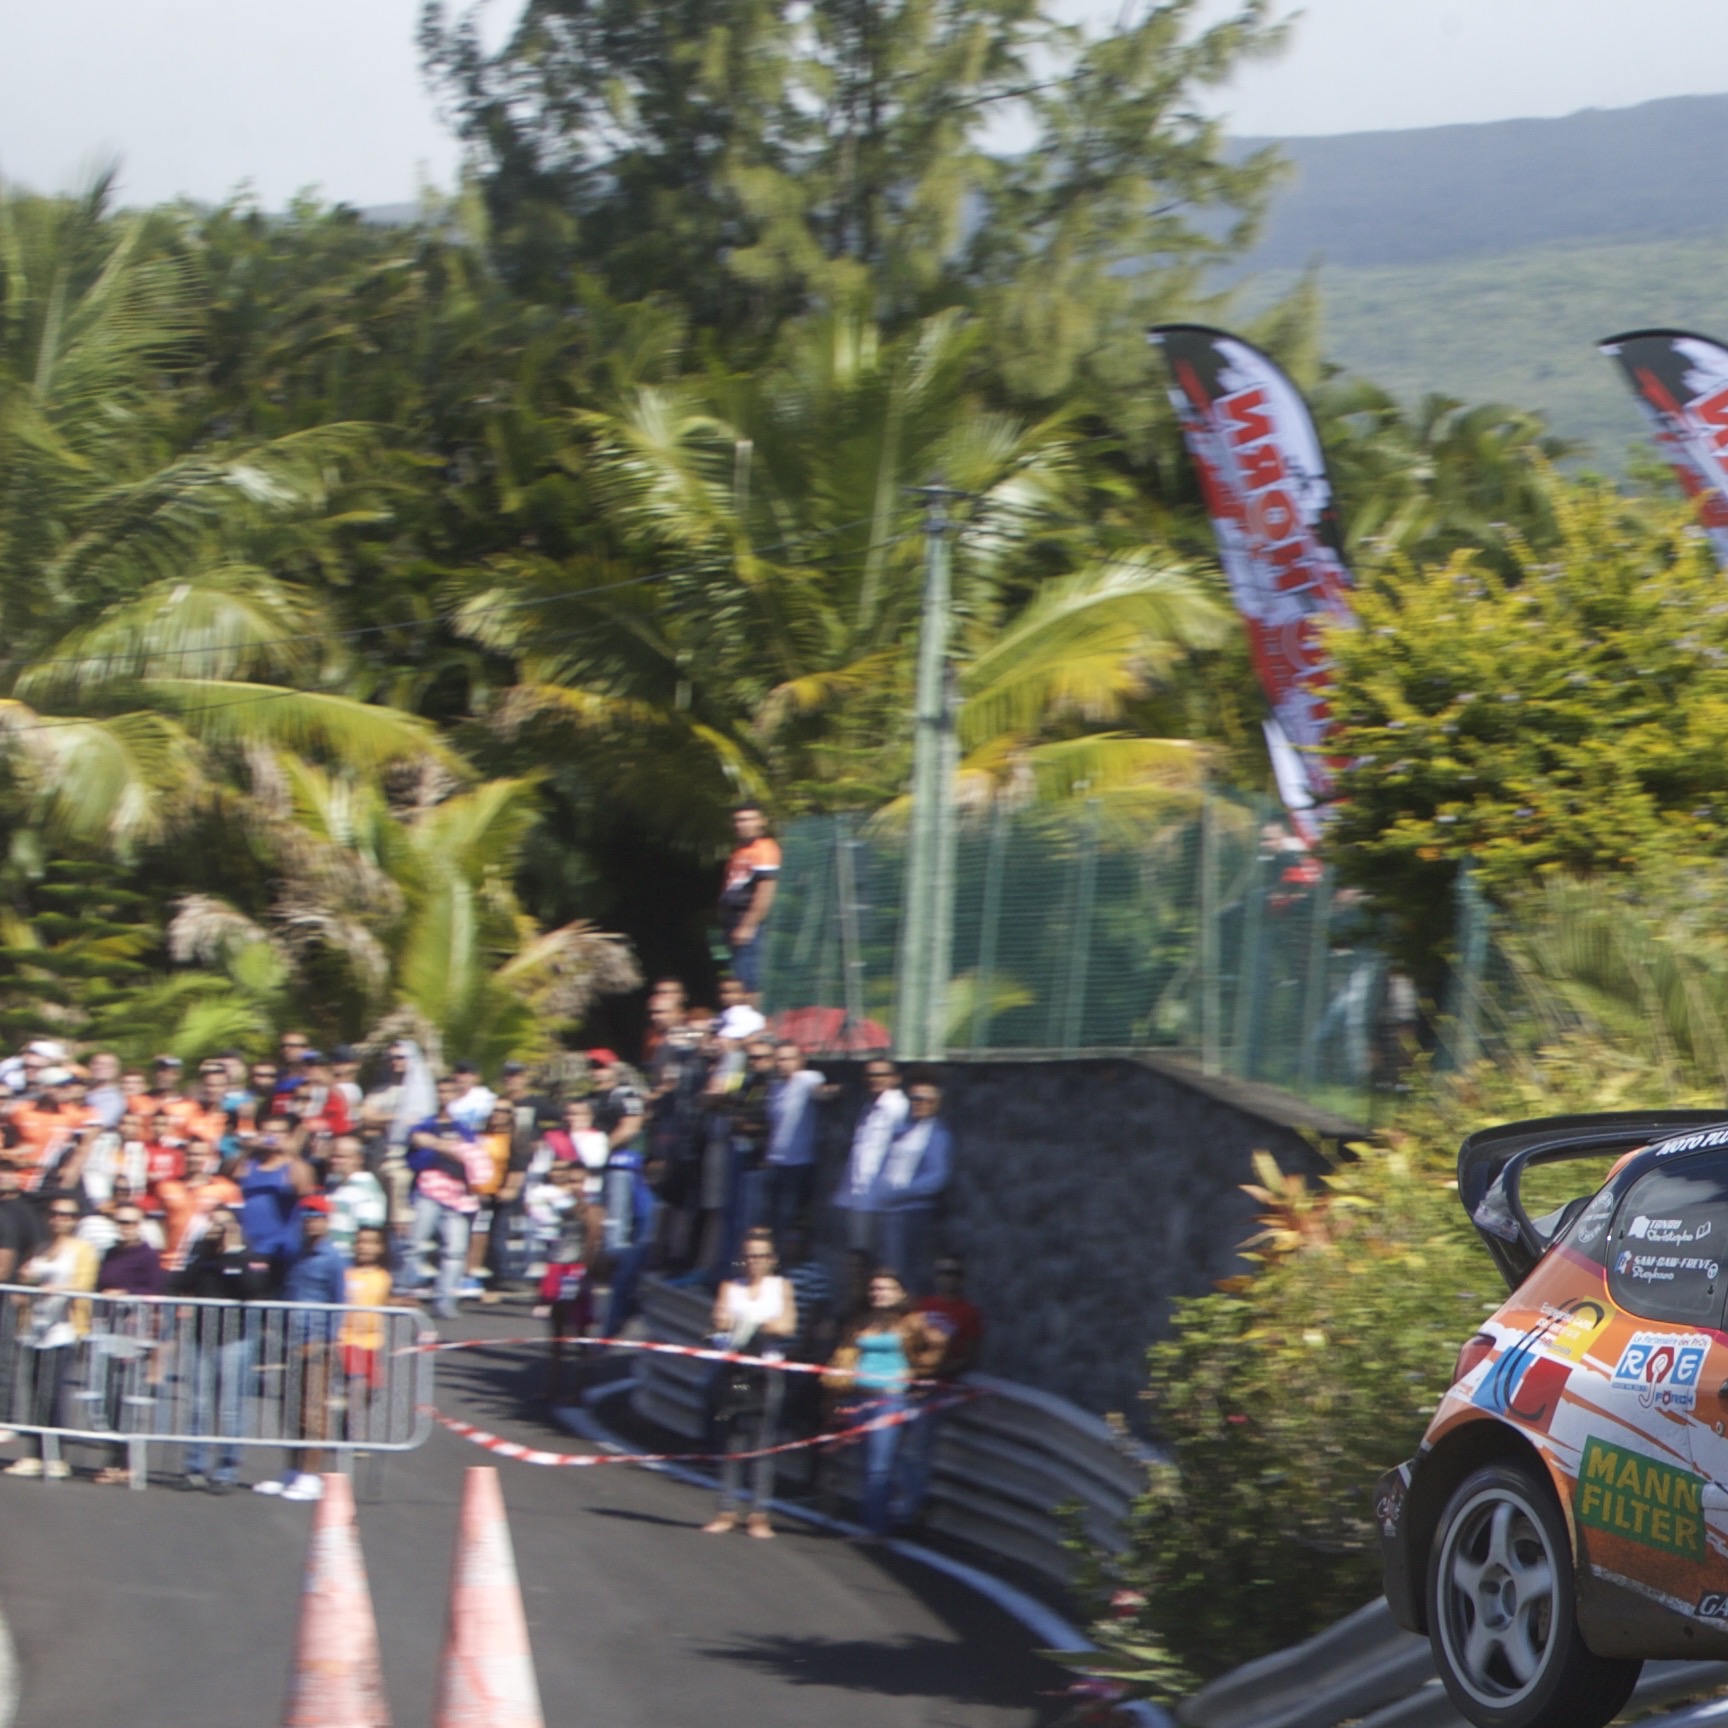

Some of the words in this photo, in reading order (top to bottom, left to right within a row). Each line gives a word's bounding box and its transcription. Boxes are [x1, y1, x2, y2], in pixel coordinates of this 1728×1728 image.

[1656, 1136, 1703, 1156] MOTO
[1586, 1445, 1698, 1515] MANN
[1581, 1482, 1698, 1550] FILTER
